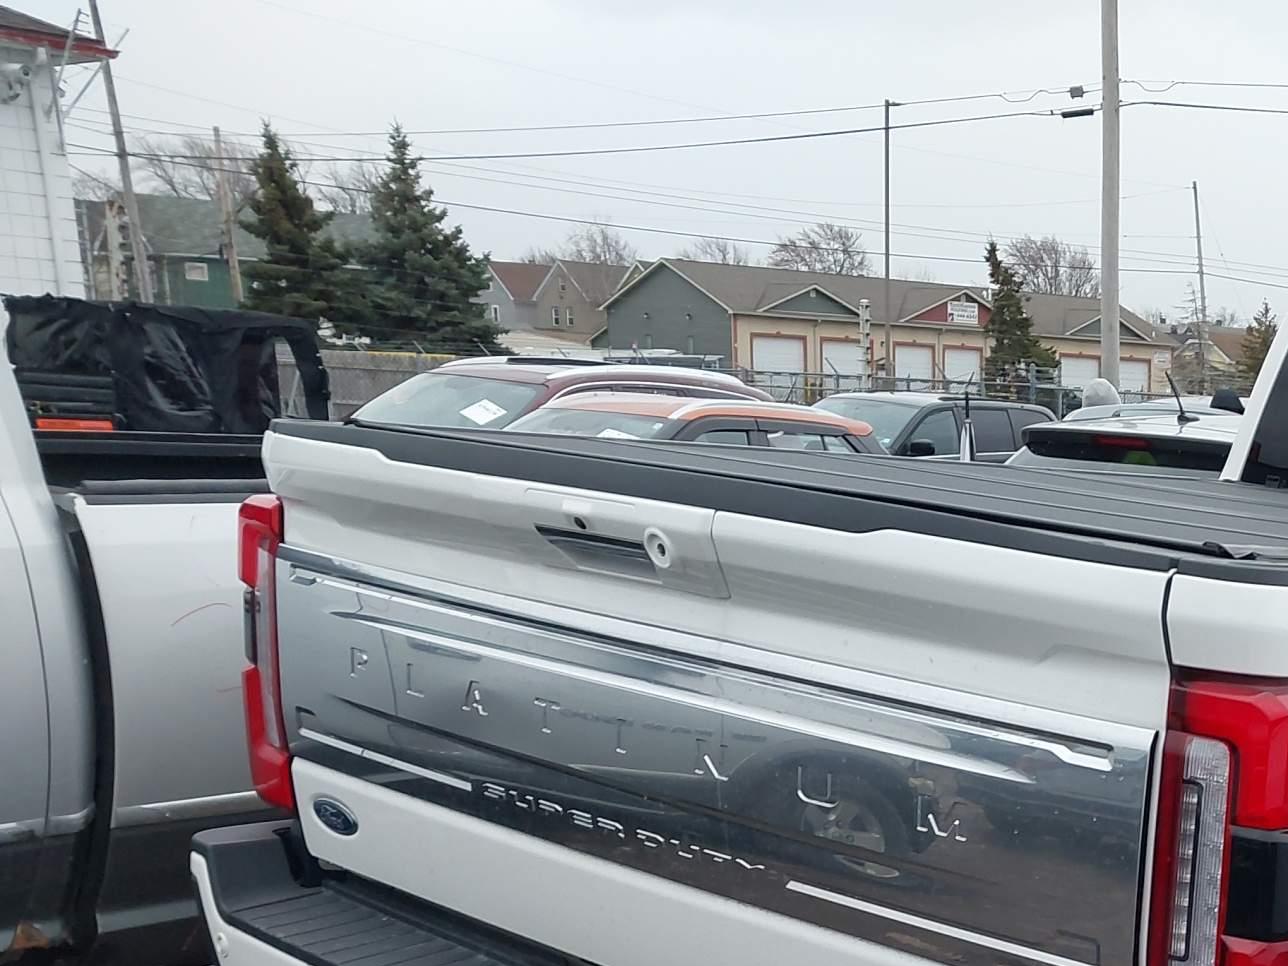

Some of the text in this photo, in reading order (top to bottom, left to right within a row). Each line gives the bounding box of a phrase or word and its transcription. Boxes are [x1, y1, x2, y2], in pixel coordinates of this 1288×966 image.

[351, 646, 967, 842] PLATINUM
[482, 783, 767, 870] SUPER DUTY
